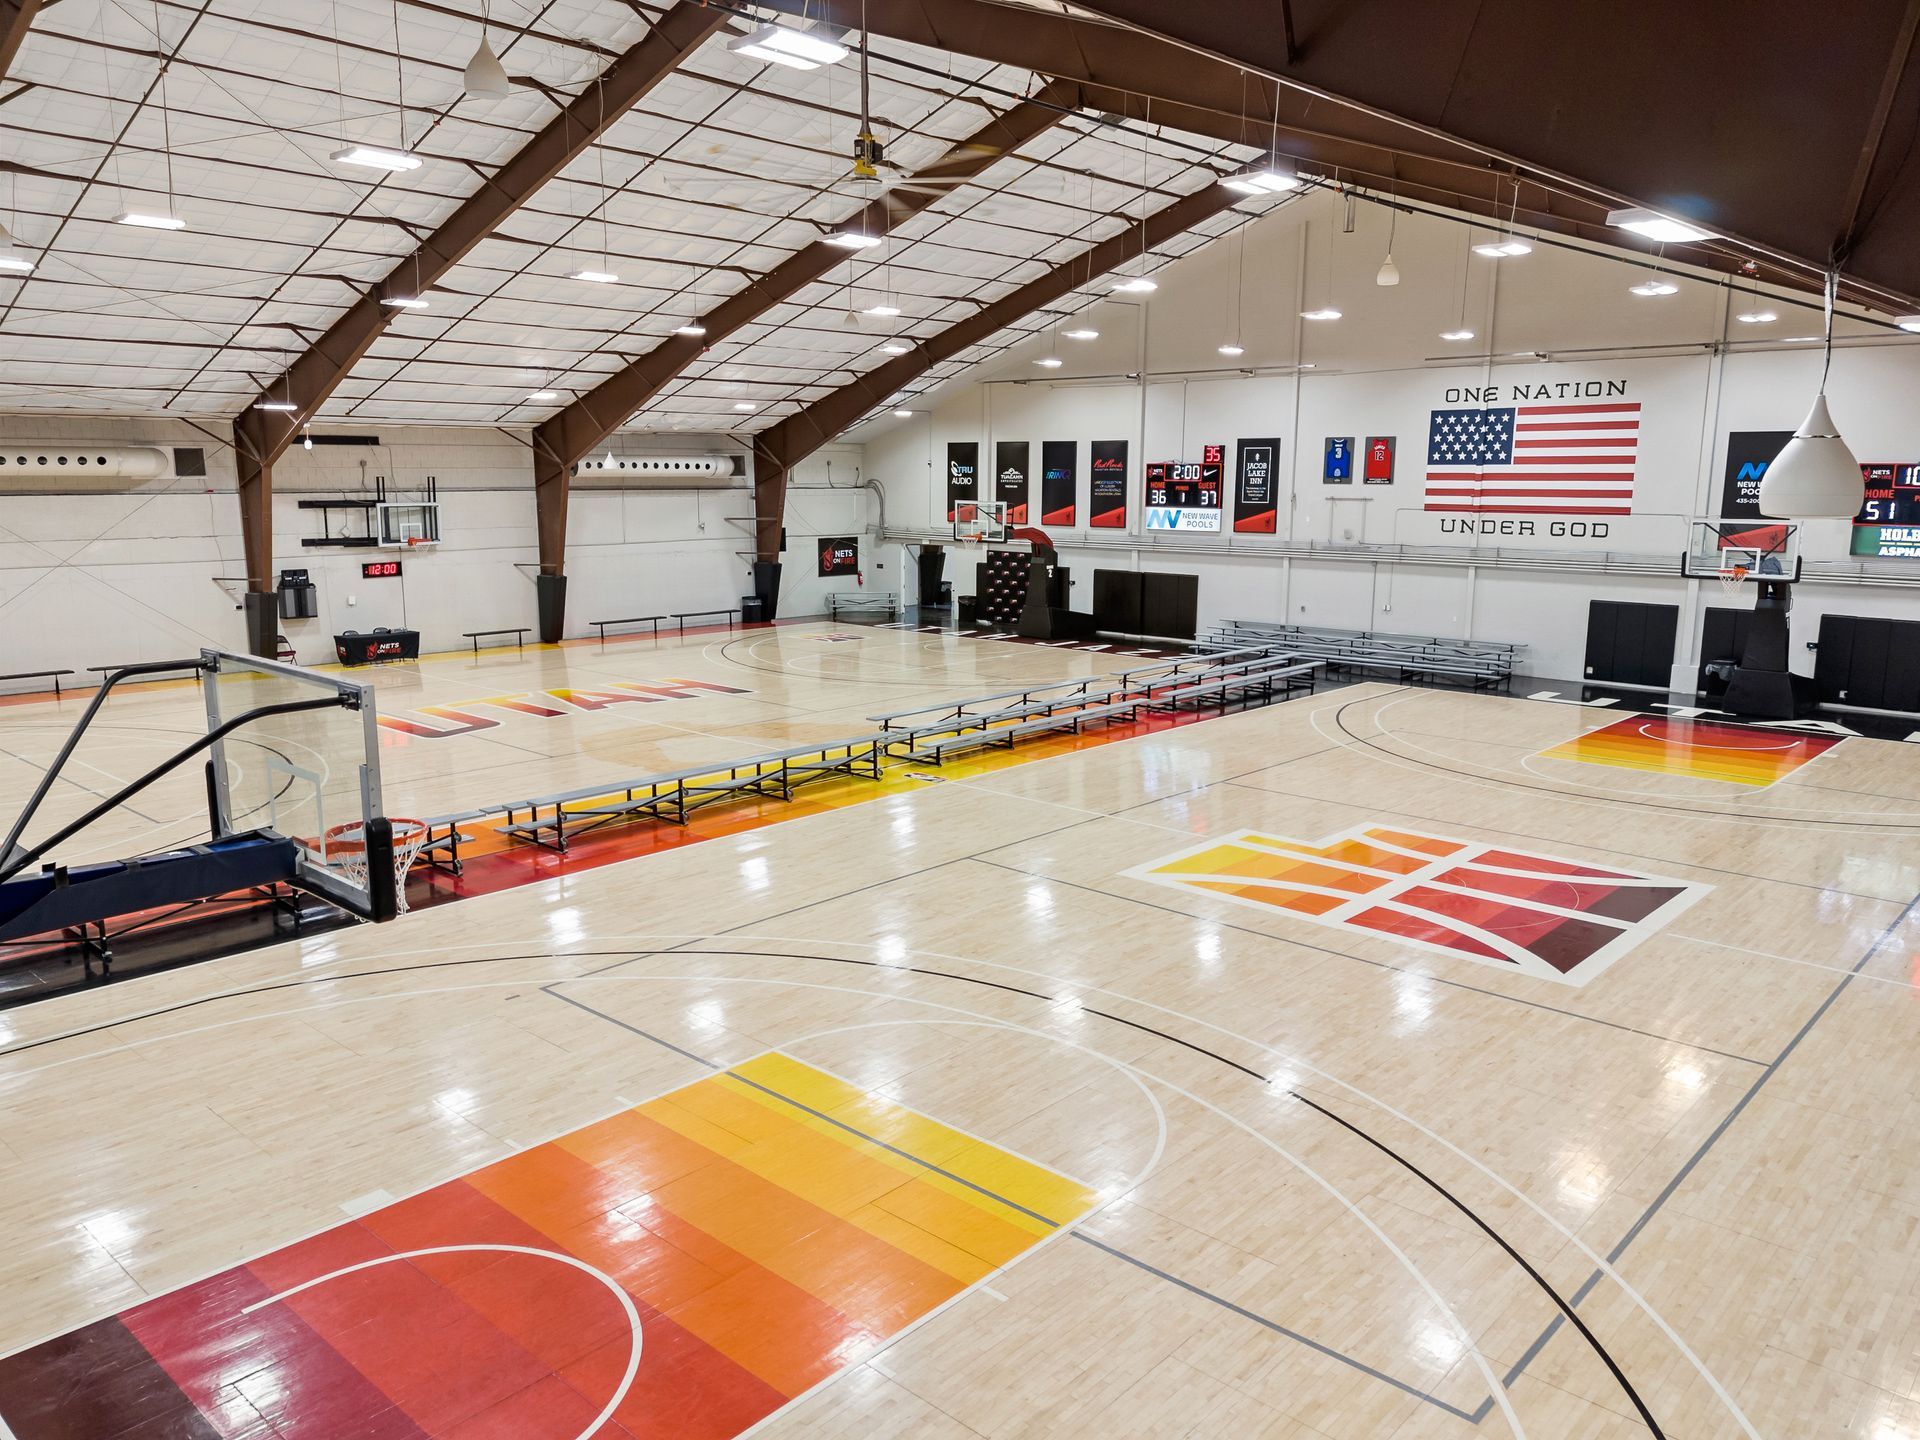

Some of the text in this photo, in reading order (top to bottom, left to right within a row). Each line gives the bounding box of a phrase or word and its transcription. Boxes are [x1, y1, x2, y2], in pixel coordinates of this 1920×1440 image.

[1445, 380, 1627, 403] ONE NATION
[1205, 447, 1220, 462] 35
[1374, 450, 1384, 461] 12
[957, 466, 973, 474] TRU
[1246, 462, 1267, 470] JACOB
[1173, 465, 1200, 480] 2:00
[951, 477, 973, 485] AUDIO
[1151, 490, 1167, 504] 36
[1200, 490, 1217, 505] 37
[1865, 489, 1895, 499] HOME
[1182, 512, 1198, 520] NEW
[1186, 520, 1213, 528] POOLS
[1440, 518, 1609, 538] UNDER GOD
[834, 549, 853, 558] NETS
[840, 557, 855, 565] FIRE
[371, 563, 397, 576] 12:00
[379, 642, 400, 650] NETS
[374, 677, 755, 739] UTAH
